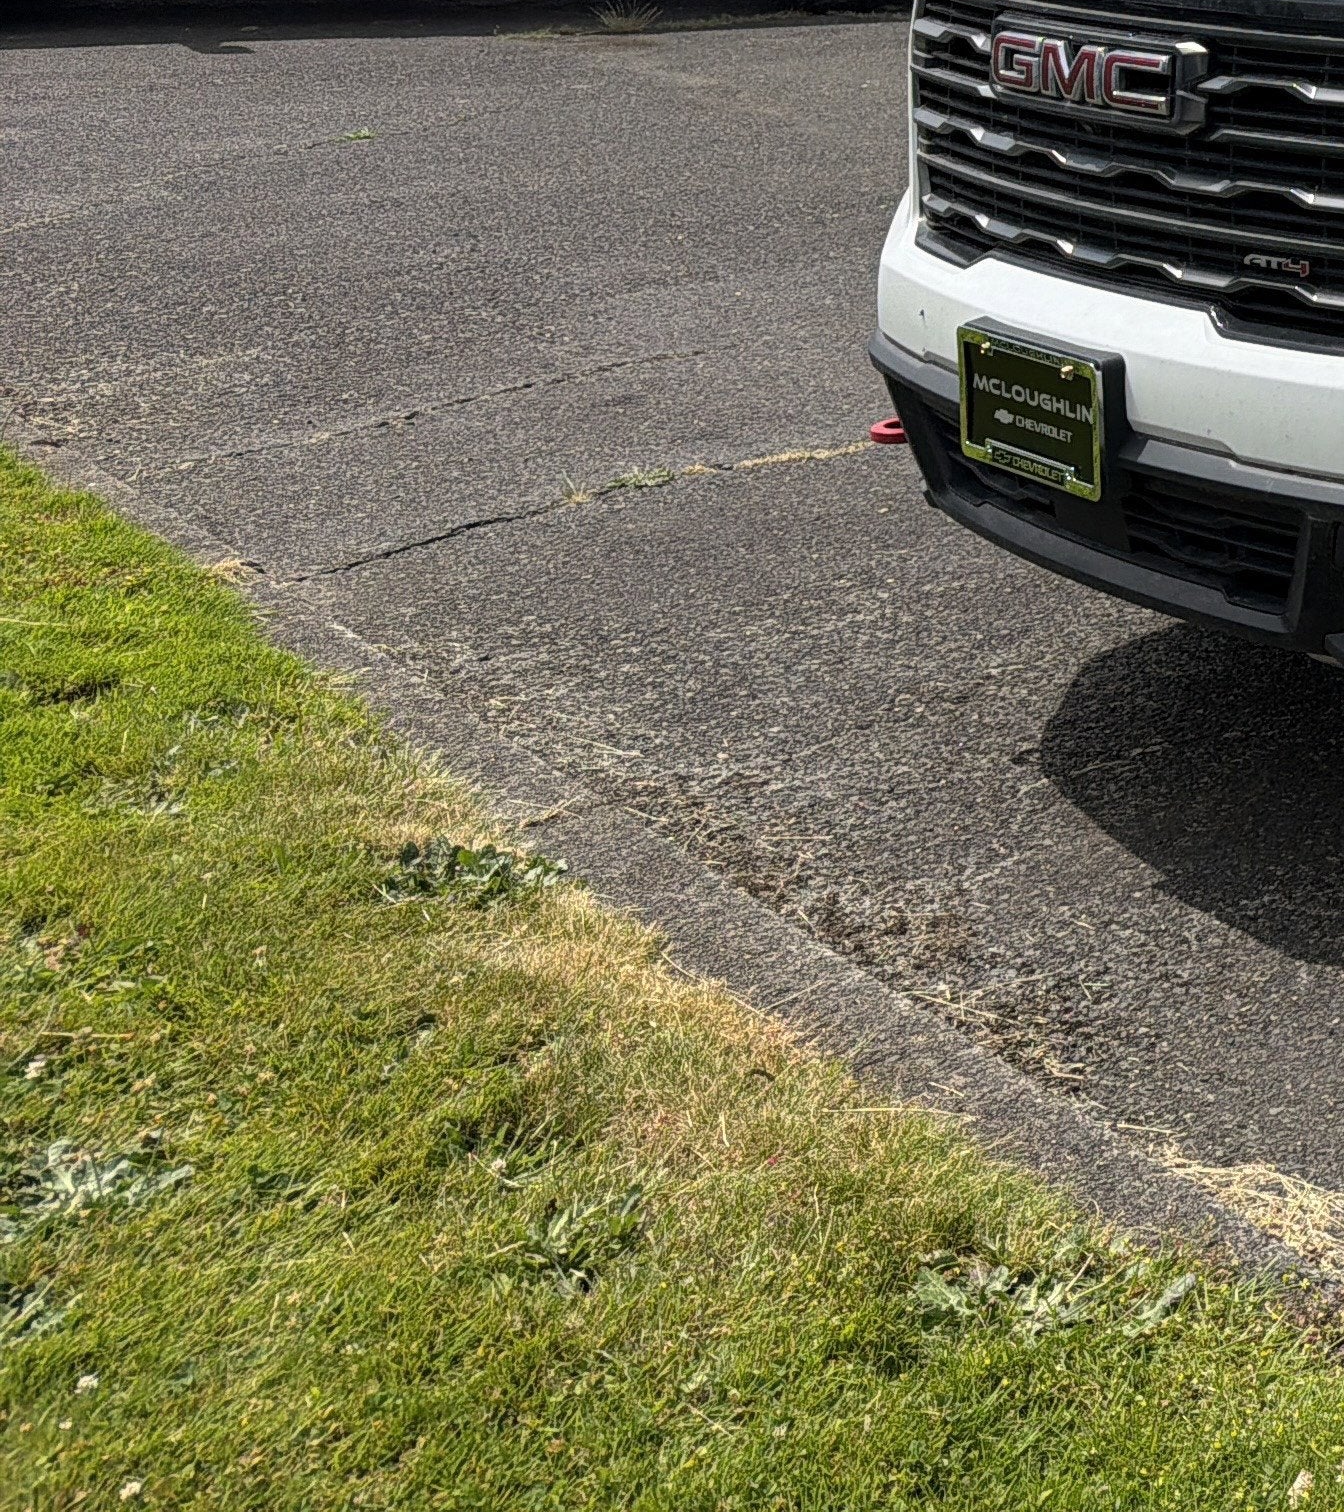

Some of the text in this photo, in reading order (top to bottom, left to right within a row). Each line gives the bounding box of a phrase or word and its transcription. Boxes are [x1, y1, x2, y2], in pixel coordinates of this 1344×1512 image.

[990, 30, 1172, 116] GMC
[1243, 253, 1310, 278] AT4
[972, 372, 1094, 425] MCLOUGHLIN
[1015, 414, 1074, 444] CHEVROLET
[1011, 458, 1064, 483] CHEVROLET
